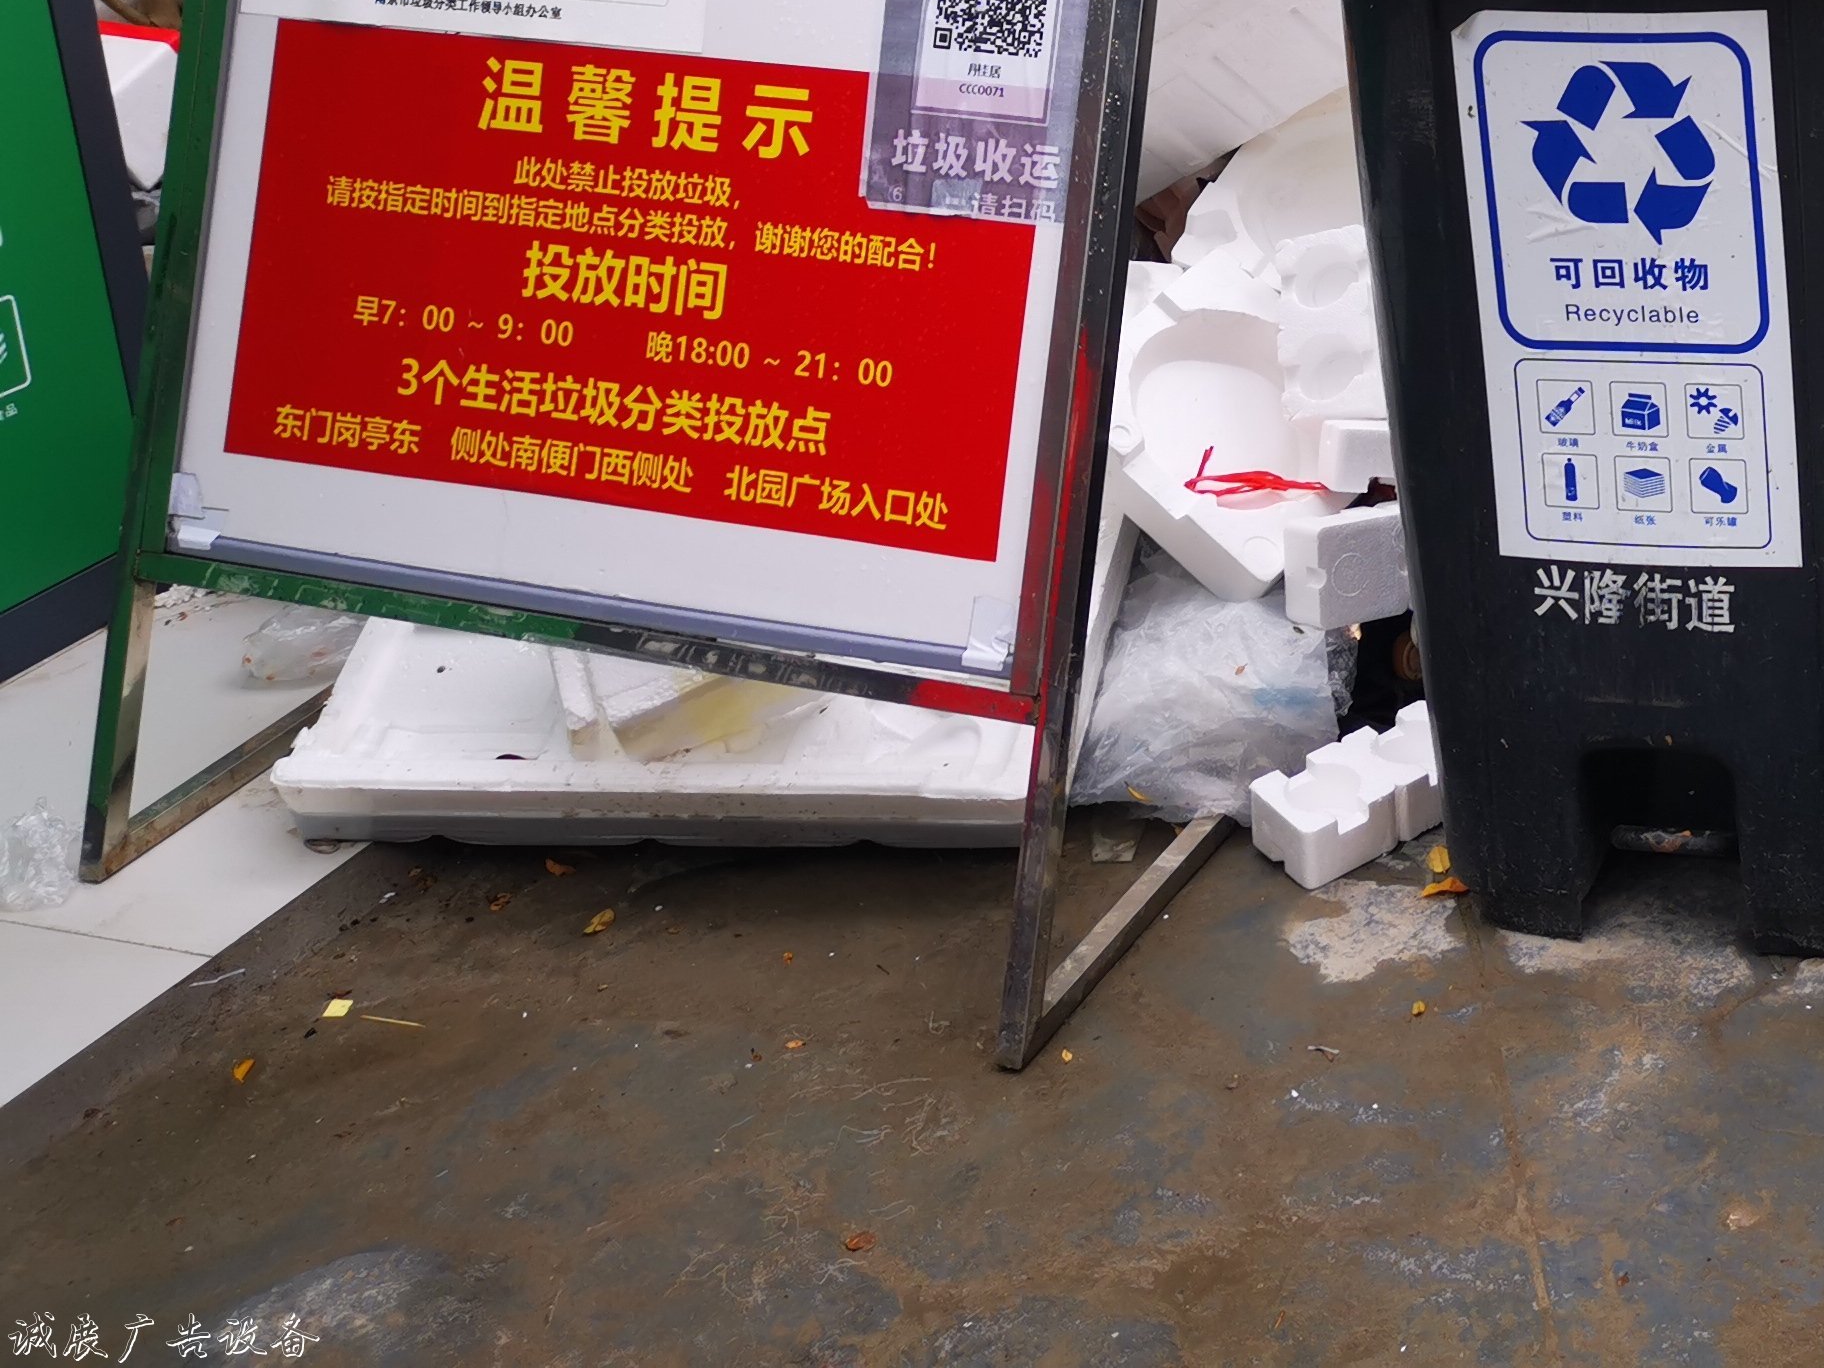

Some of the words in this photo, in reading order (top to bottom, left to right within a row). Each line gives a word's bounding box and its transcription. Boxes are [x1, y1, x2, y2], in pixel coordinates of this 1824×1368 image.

[478, 56, 814, 159] 温馨提示
[891, 128, 1062, 189] 垃圾收运
[514, 156, 741, 210] 此处禁止投放垃圾，
[522, 240, 728, 320] 投放时间
[1550, 257, 1709, 291] 可回收物
[1565, 303, 1700, 326] Recyclable
[397, 358, 831, 456] 3个生活垃圾分类投放点
[1557, 437, 1579, 448] 玻璃
[1625, 441, 1659, 452] 牛奶盒
[1706, 443, 1728, 454] 金属
[273, 404, 421, 455] 东门岗亭东
[450, 426, 693, 494] 侧处南便门西侧处
[724, 464, 949, 530] 北园广场入口处
[1562, 512, 1583, 523] 塑料
[1634, 515, 1657, 526] 纸张
[1704, 517, 1737, 528] 可乐罐
[1534, 565, 1736, 632] 兴隆街道
